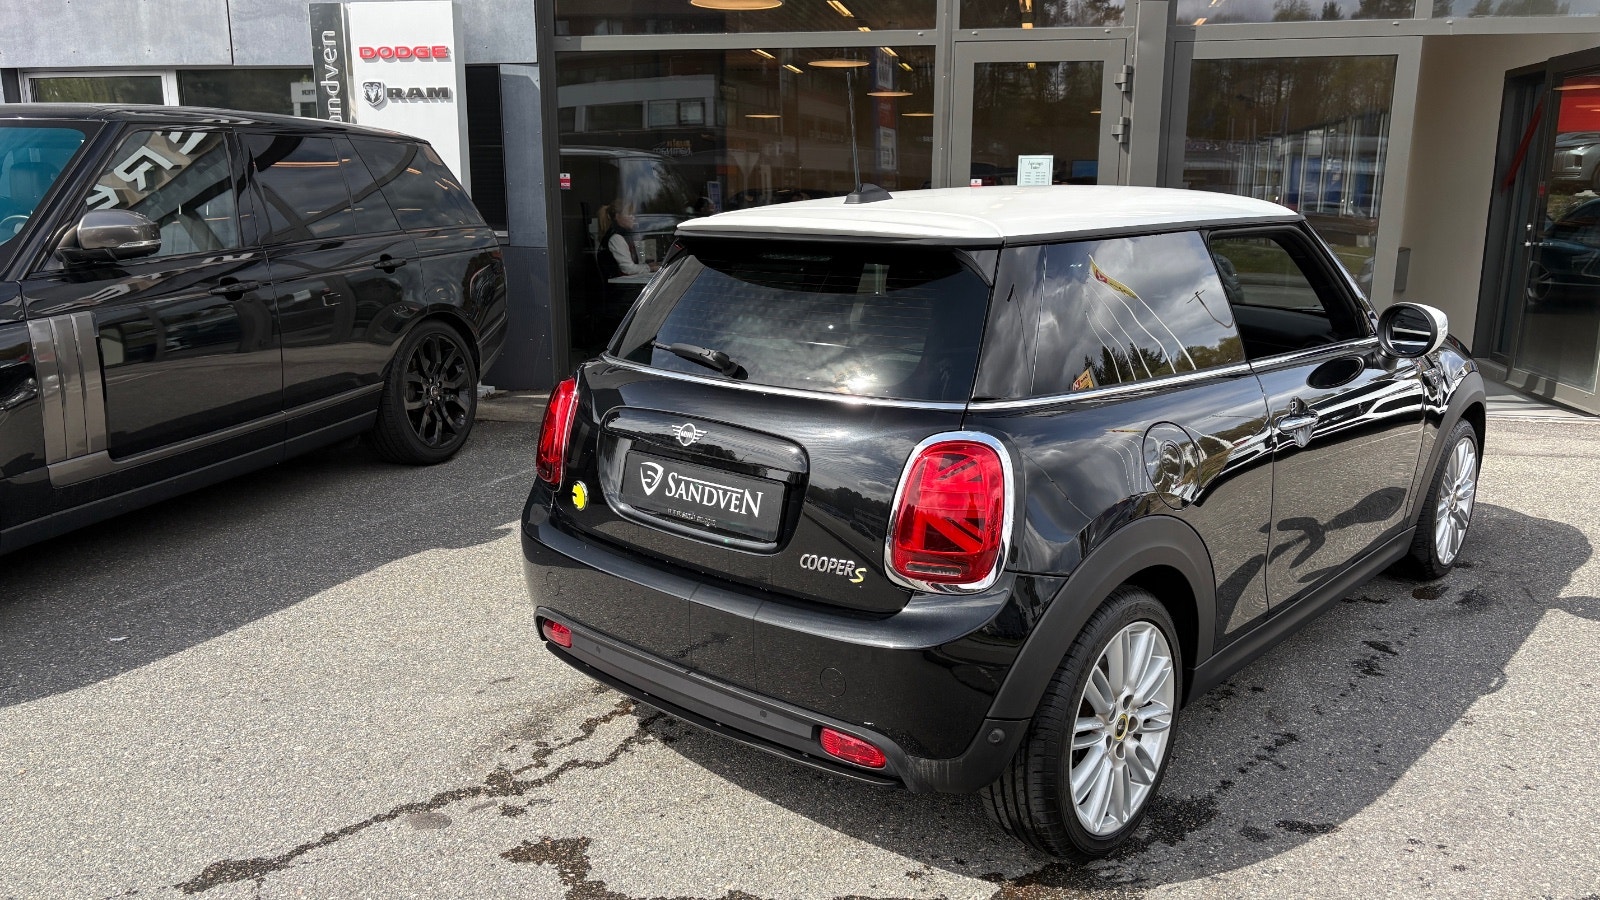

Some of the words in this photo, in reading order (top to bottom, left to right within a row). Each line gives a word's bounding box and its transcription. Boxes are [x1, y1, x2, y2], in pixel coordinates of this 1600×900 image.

[359, 46, 449, 59] DODGE
[386, 87, 450, 99] RAM
[665, 472, 764, 518] SANDVEN
[799, 553, 854, 577] COOPER
[850, 567, 867, 583] S
